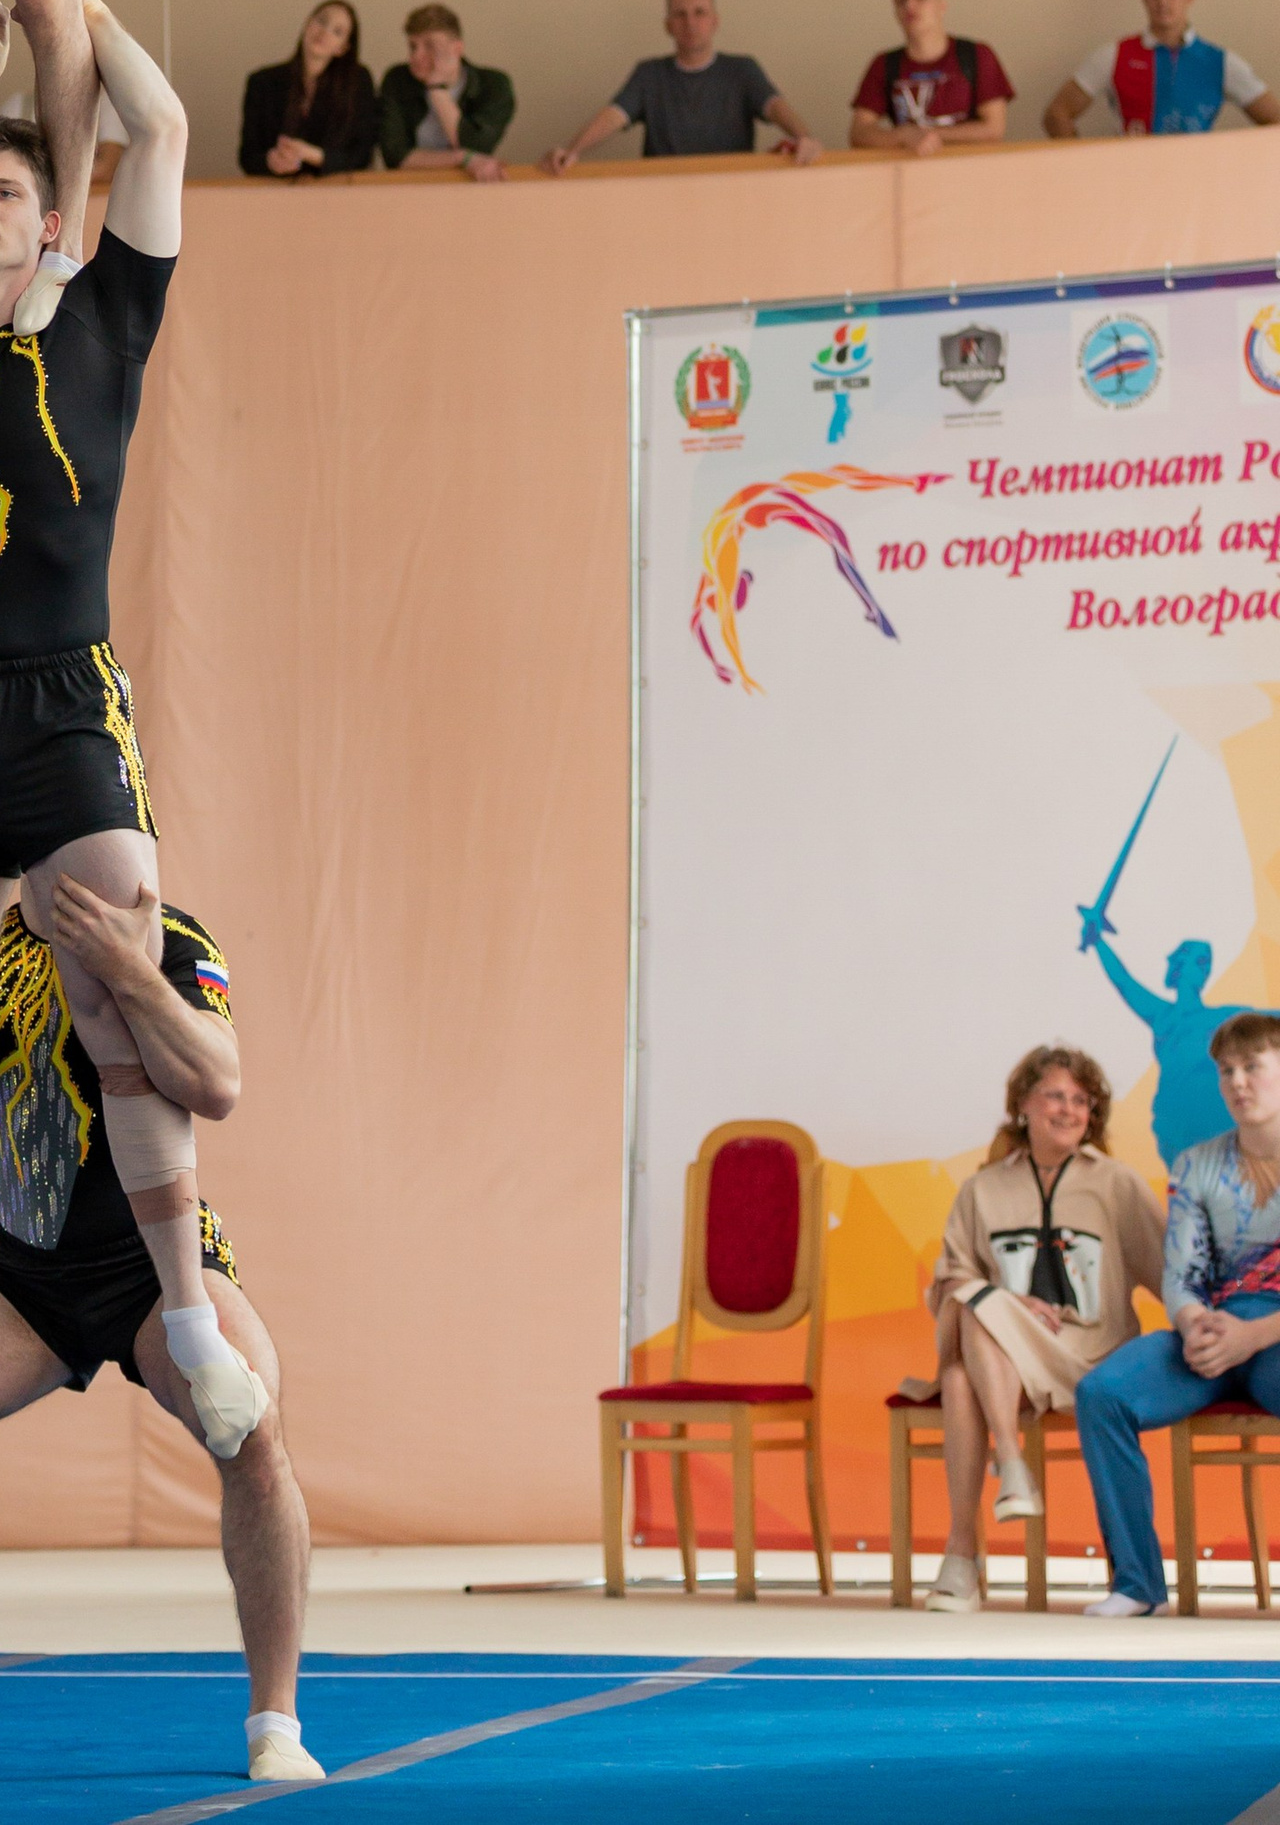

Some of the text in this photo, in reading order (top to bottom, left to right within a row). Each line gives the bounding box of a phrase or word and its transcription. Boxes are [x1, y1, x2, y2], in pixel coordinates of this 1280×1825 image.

[968, 453, 1223, 498] Чемпионат
[878, 541, 927, 571] по
[942, 506, 1203, 578] спортивной
